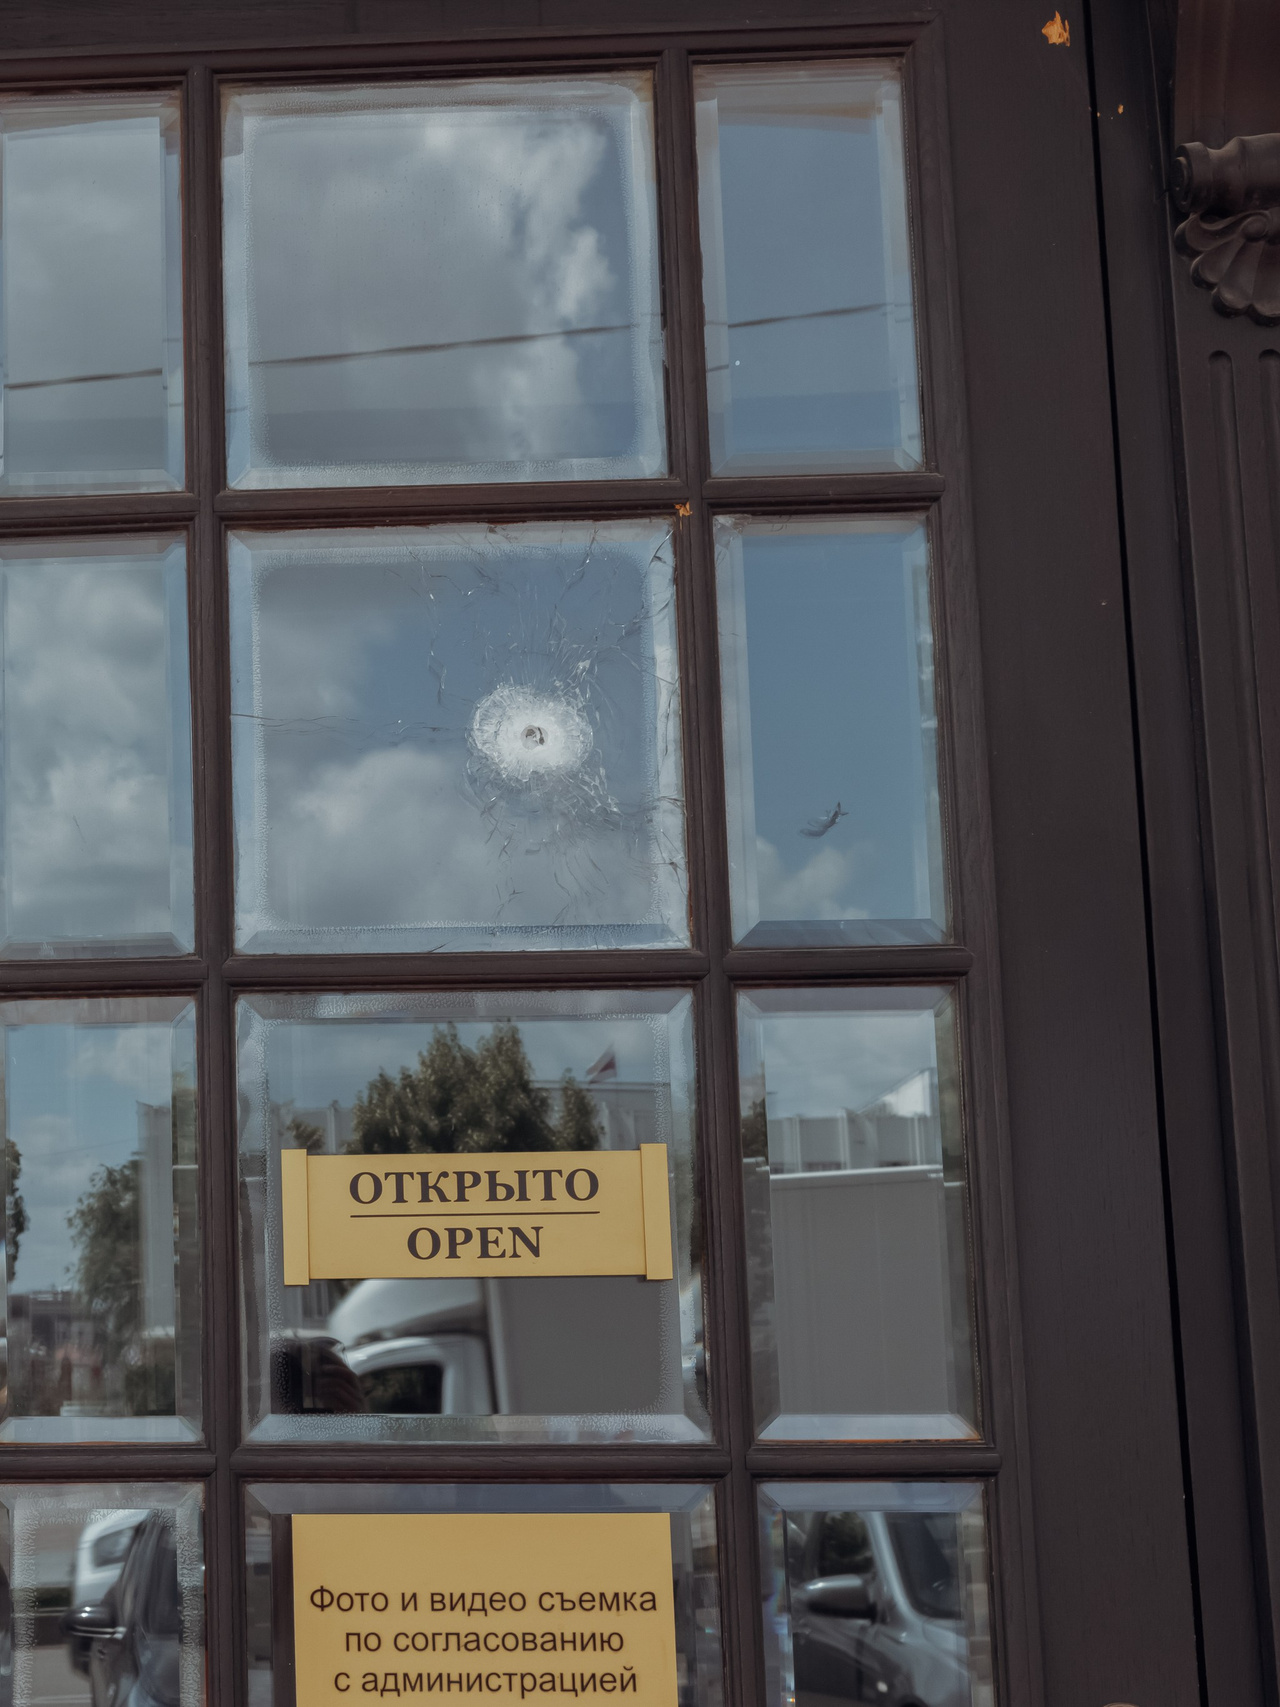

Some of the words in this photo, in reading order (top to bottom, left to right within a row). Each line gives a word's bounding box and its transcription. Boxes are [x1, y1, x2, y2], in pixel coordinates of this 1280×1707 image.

[349, 1168, 599, 1205] ОТКРЫТО
[407, 1226, 544, 1261] OPEN
[309, 1585, 389, 1613] Фото
[401, 1592, 418, 1612] и
[430, 1591, 527, 1617] видео
[538, 1591, 658, 1613] съемка
[345, 1631, 382, 1653] по
[393, 1631, 624, 1653] согласованию
[333, 1671, 351, 1693] с
[361, 1665, 637, 1700] администрацией
